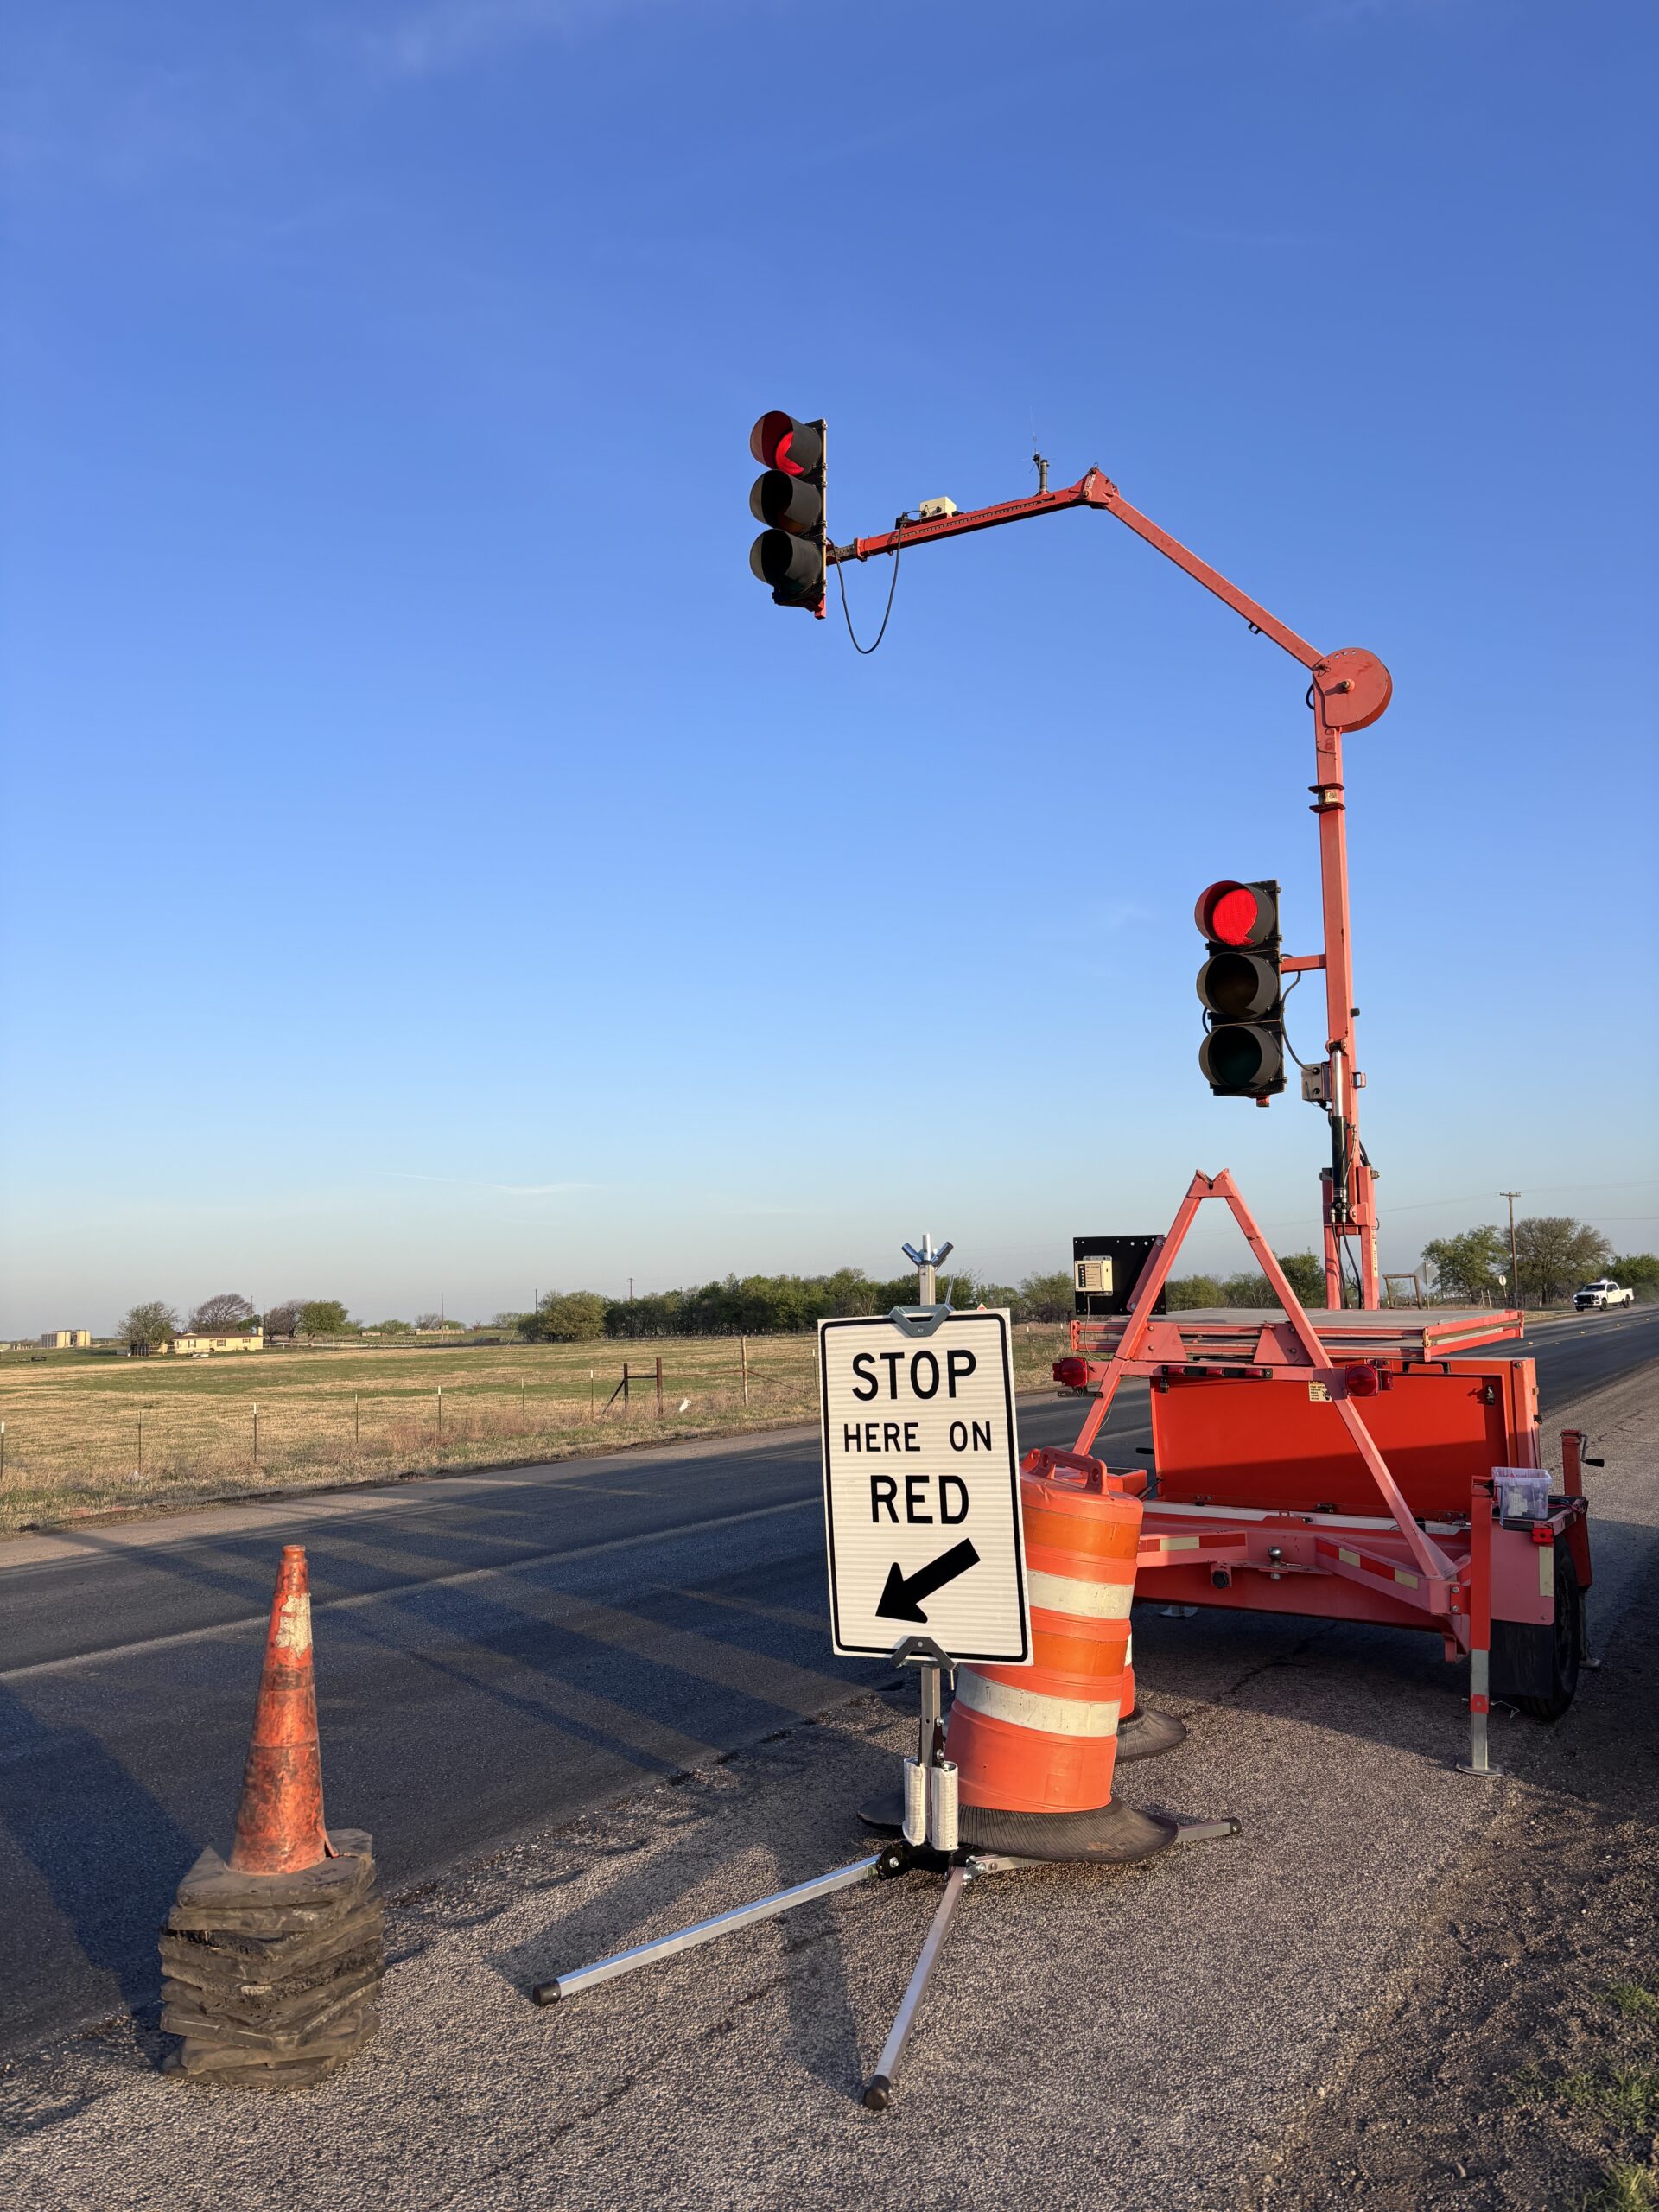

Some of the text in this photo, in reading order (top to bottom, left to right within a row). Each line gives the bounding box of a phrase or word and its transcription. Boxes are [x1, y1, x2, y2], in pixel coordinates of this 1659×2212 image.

[852, 1350, 976, 1402] STOP
[843, 1421, 992, 1452] HERE ON
[870, 1475, 969, 1525] RED
